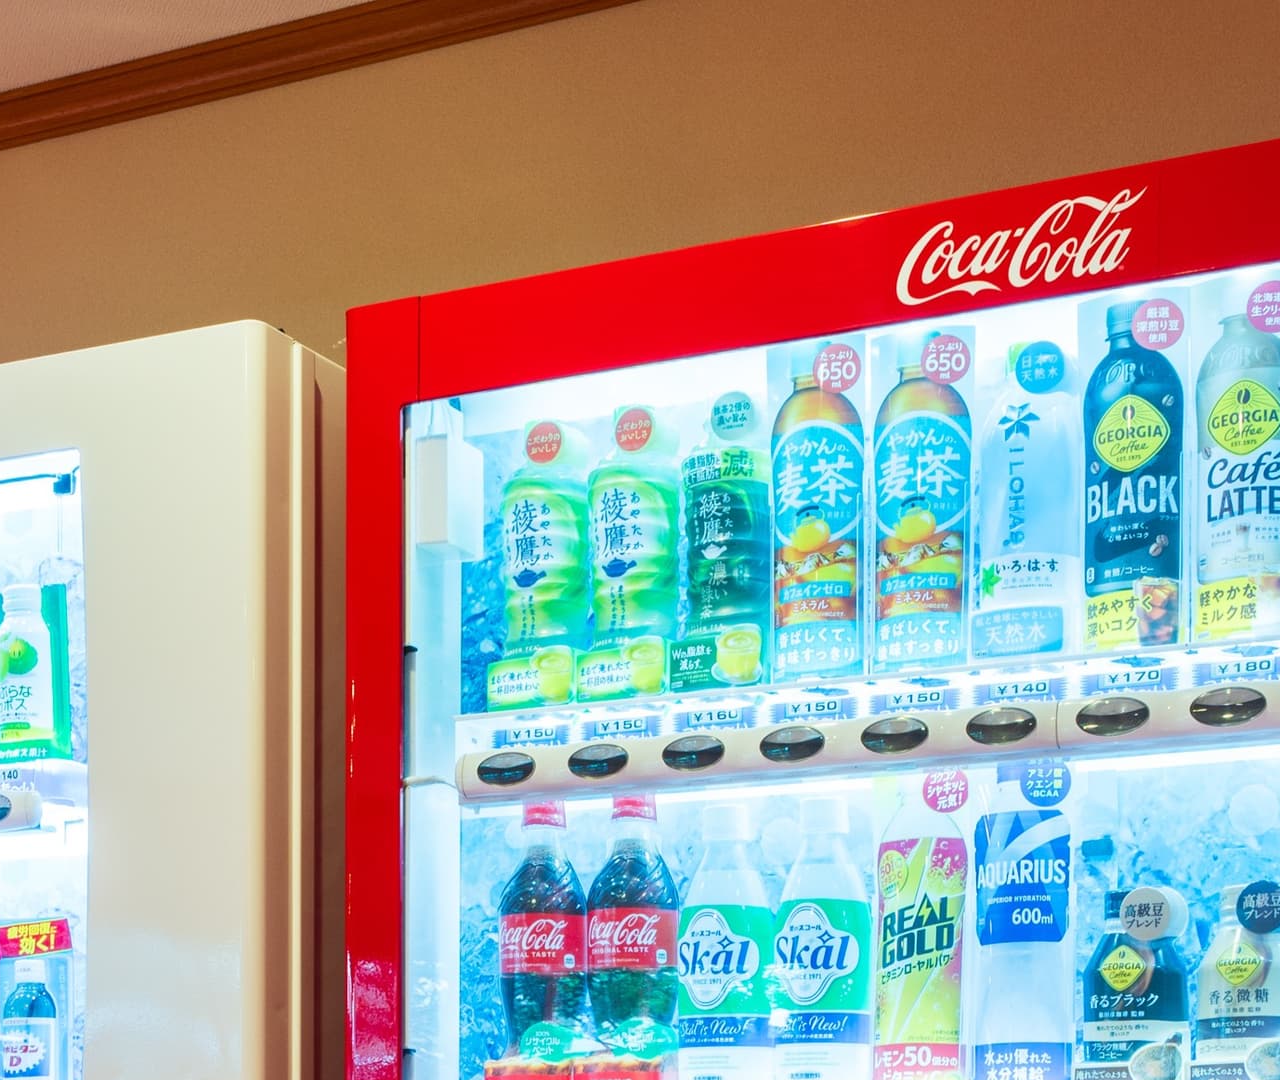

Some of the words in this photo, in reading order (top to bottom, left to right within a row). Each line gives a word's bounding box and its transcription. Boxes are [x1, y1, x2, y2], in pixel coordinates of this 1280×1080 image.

[896, 186, 1148, 305] Coca-Cola
[925, 352, 966, 372] 650
[1211, 410, 1278, 430] GEORGIA
[1098, 427, 1163, 446] GEORGIA
[1224, 425, 1265, 440] Coffee
[878, 445, 960, 508] 麦茶
[1088, 475, 1179, 523] BLACK
[885, 576, 949, 591] カフェインゼロ
[1200, 583, 1257, 607] 軽やかな
[1087, 595, 1153, 620] 飲みやすく
[1201, 603, 1257, 625] ミルク感
[985, 623, 1046, 645] 天然水
[1087, 616, 1138, 639] 深いコク
[1218, 660, 1271, 674] ¥180
[977, 859, 1066, 889] AQUARIUS
[19, 936, 56, 955] 効く!
[882, 929, 954, 969] GOLD
[1090, 993, 1159, 1008] 香るブラック
[1209, 989, 1269, 1004] 香る微糖
[984, 1048, 1052, 1067] 水より優れた
